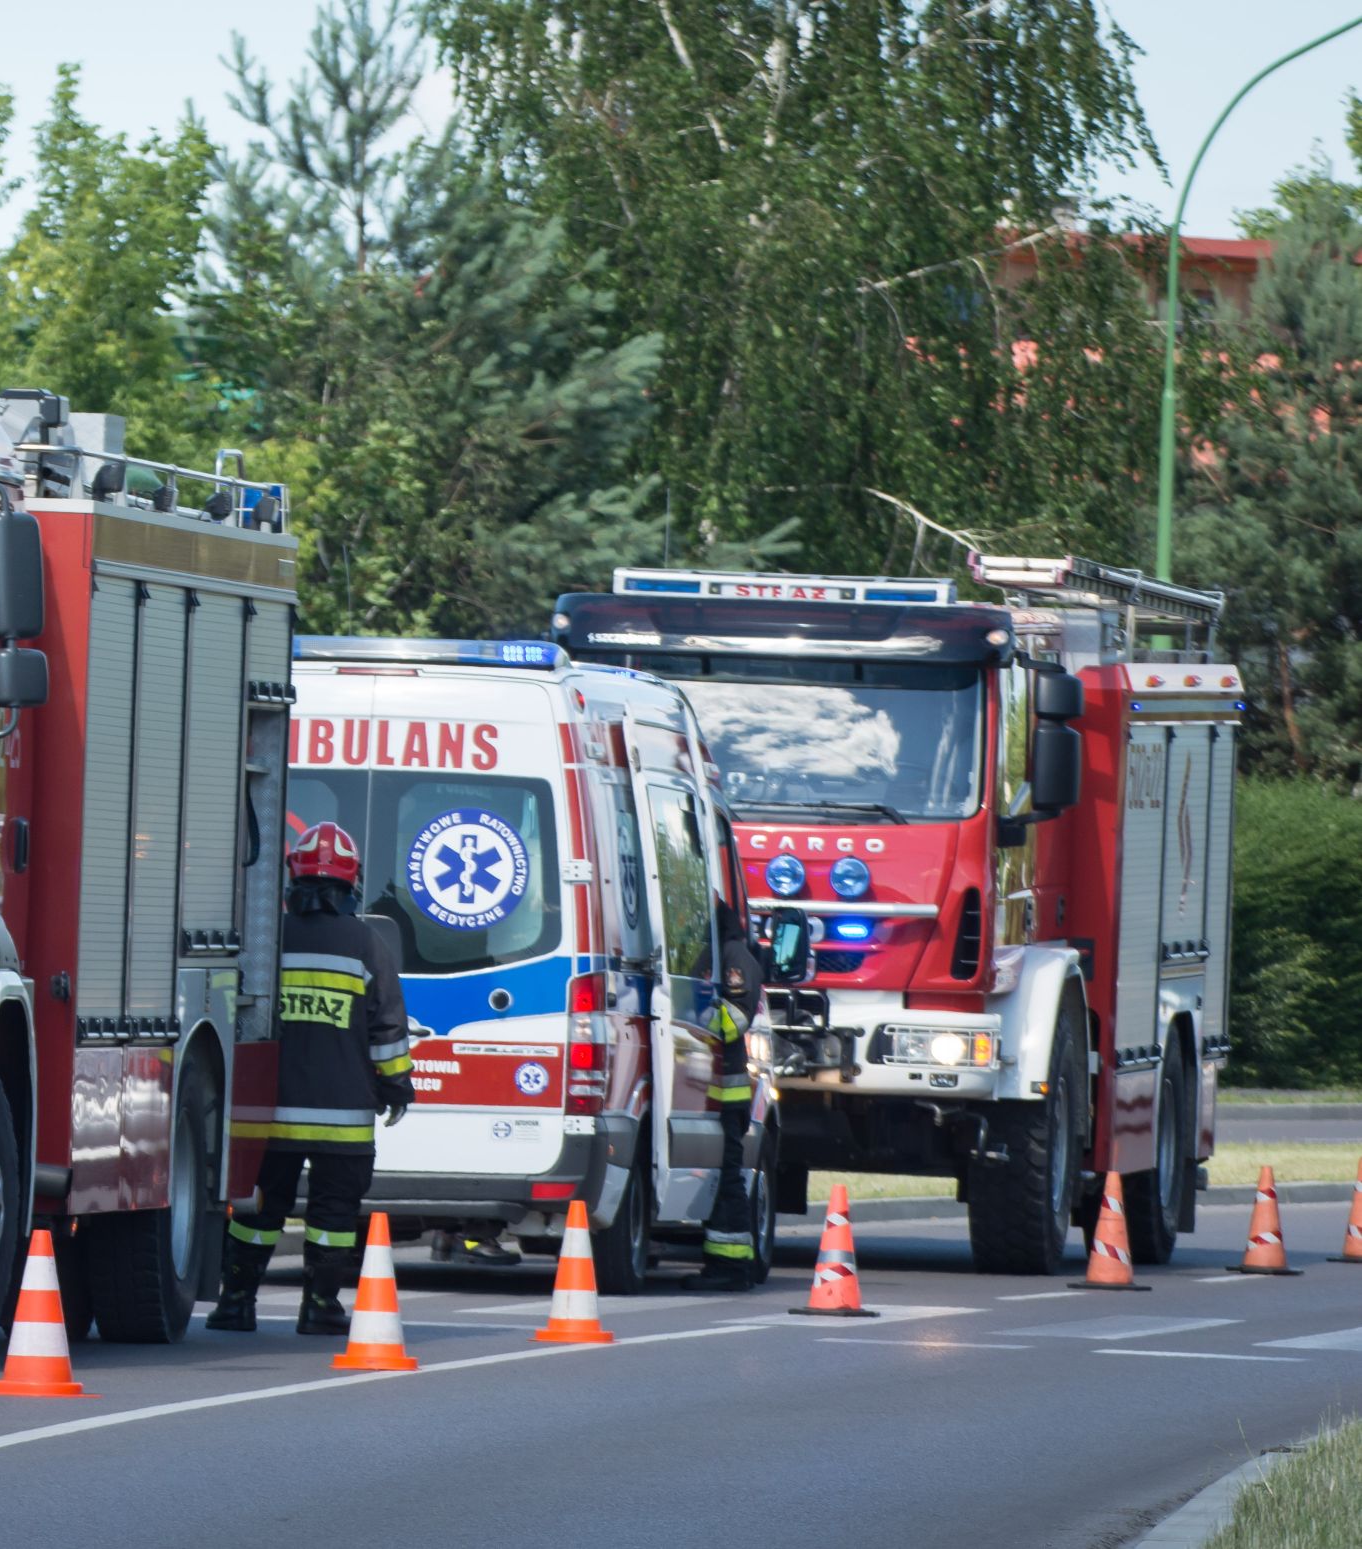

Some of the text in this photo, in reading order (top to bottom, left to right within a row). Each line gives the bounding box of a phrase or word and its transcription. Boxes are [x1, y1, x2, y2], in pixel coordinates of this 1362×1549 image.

[407, 812, 527, 896] PAŃSTWOWE RATOWNICTWO
[733, 834, 885, 853] CARGO
[427, 902, 505, 928] MEDYCZNE
[410, 1076, 443, 1092] ELCU
